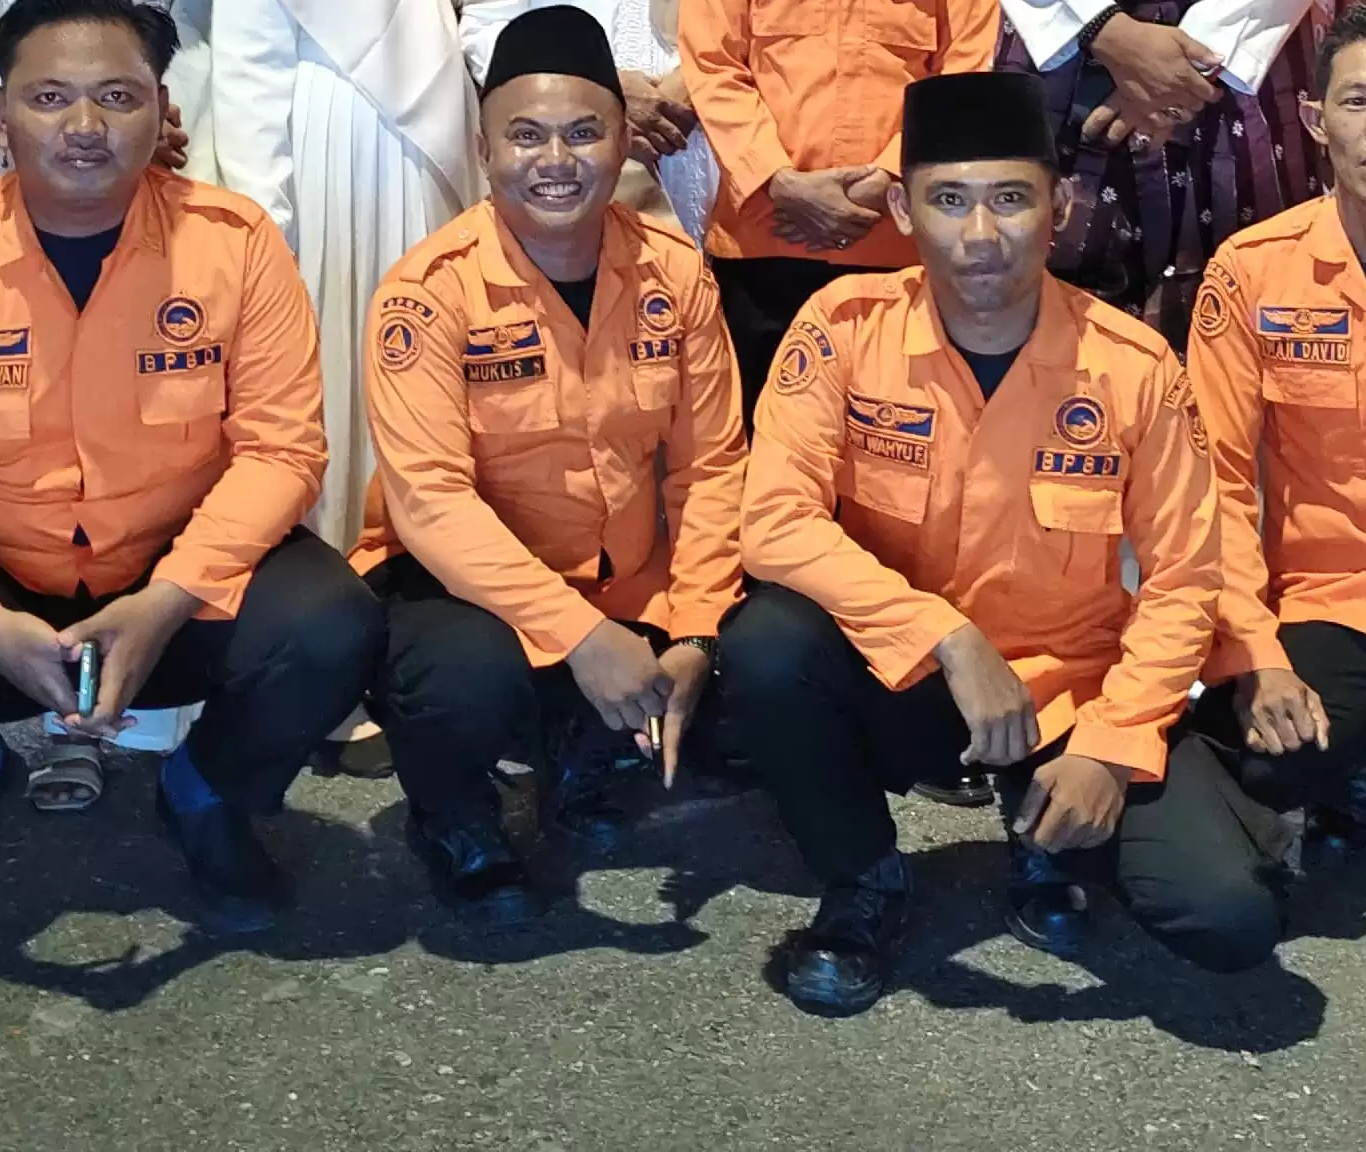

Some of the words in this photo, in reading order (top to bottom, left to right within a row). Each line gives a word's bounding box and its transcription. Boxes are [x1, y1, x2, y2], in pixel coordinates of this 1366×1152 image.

[144, 348, 214, 373] BPBD
[1302, 342, 1346, 362] DAVID
[468, 360, 523, 381] MUKLIS
[1042, 452, 1113, 475] BPBD
